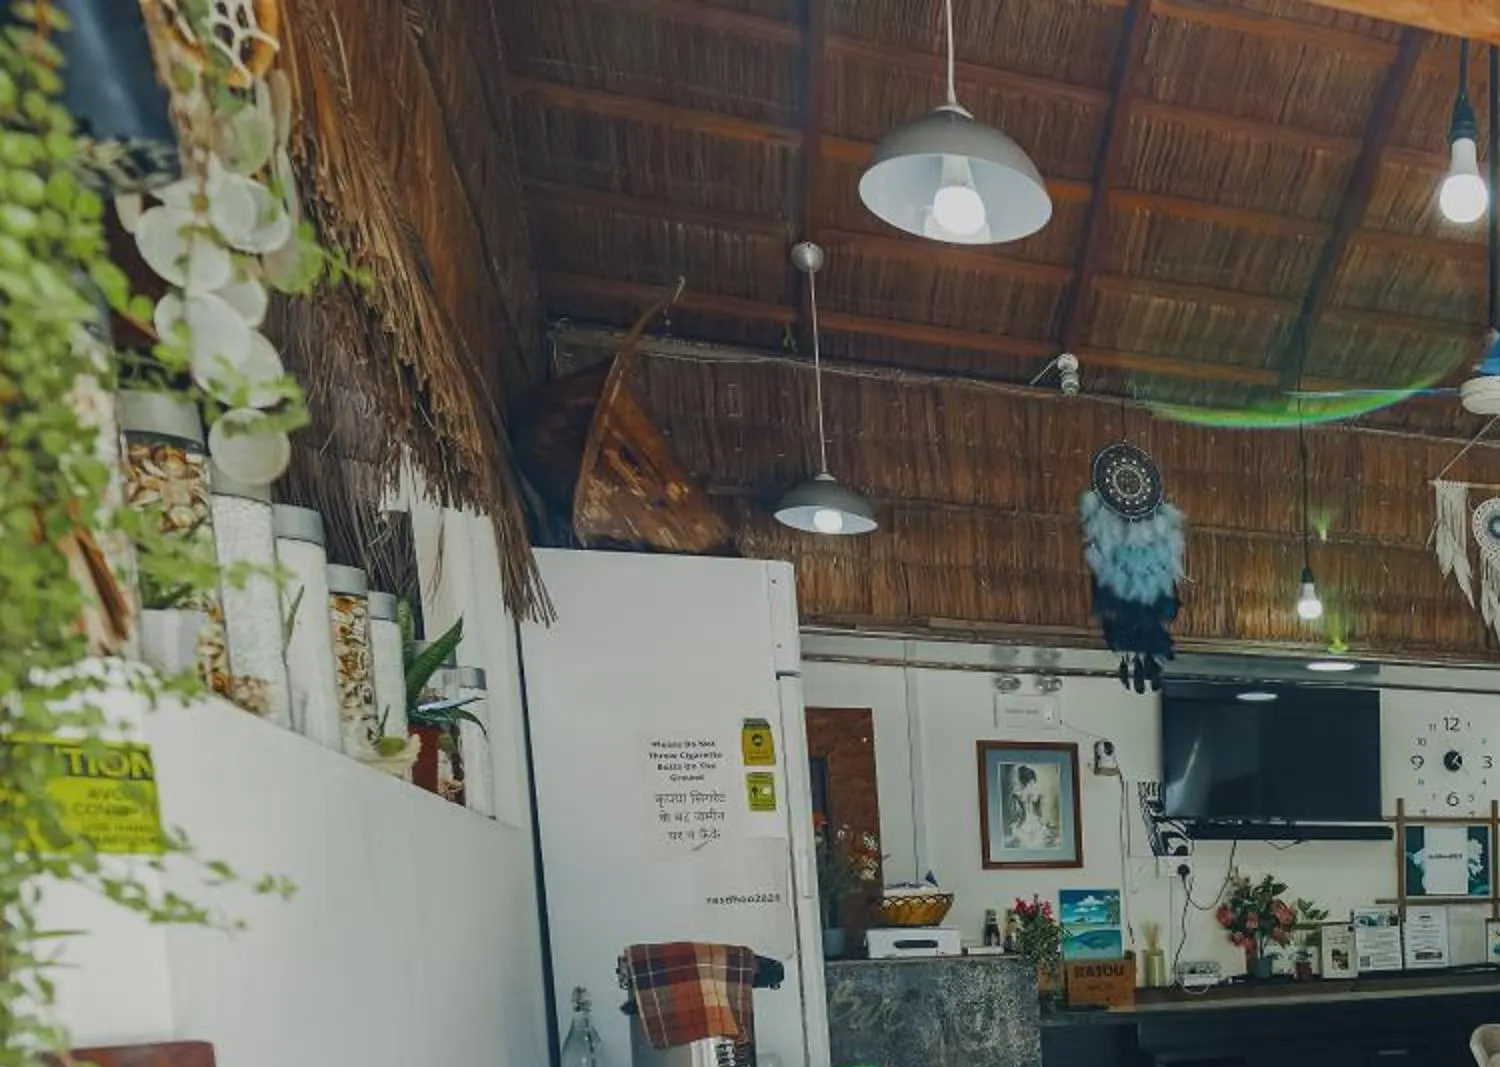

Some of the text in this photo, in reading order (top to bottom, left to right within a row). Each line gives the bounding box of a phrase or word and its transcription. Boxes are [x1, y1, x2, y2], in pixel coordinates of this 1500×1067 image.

[1443, 716, 1460, 732] 12
[1410, 755, 1425, 771] 9
[1482, 755, 1493, 769] 3
[1446, 791, 1460, 807] 6
